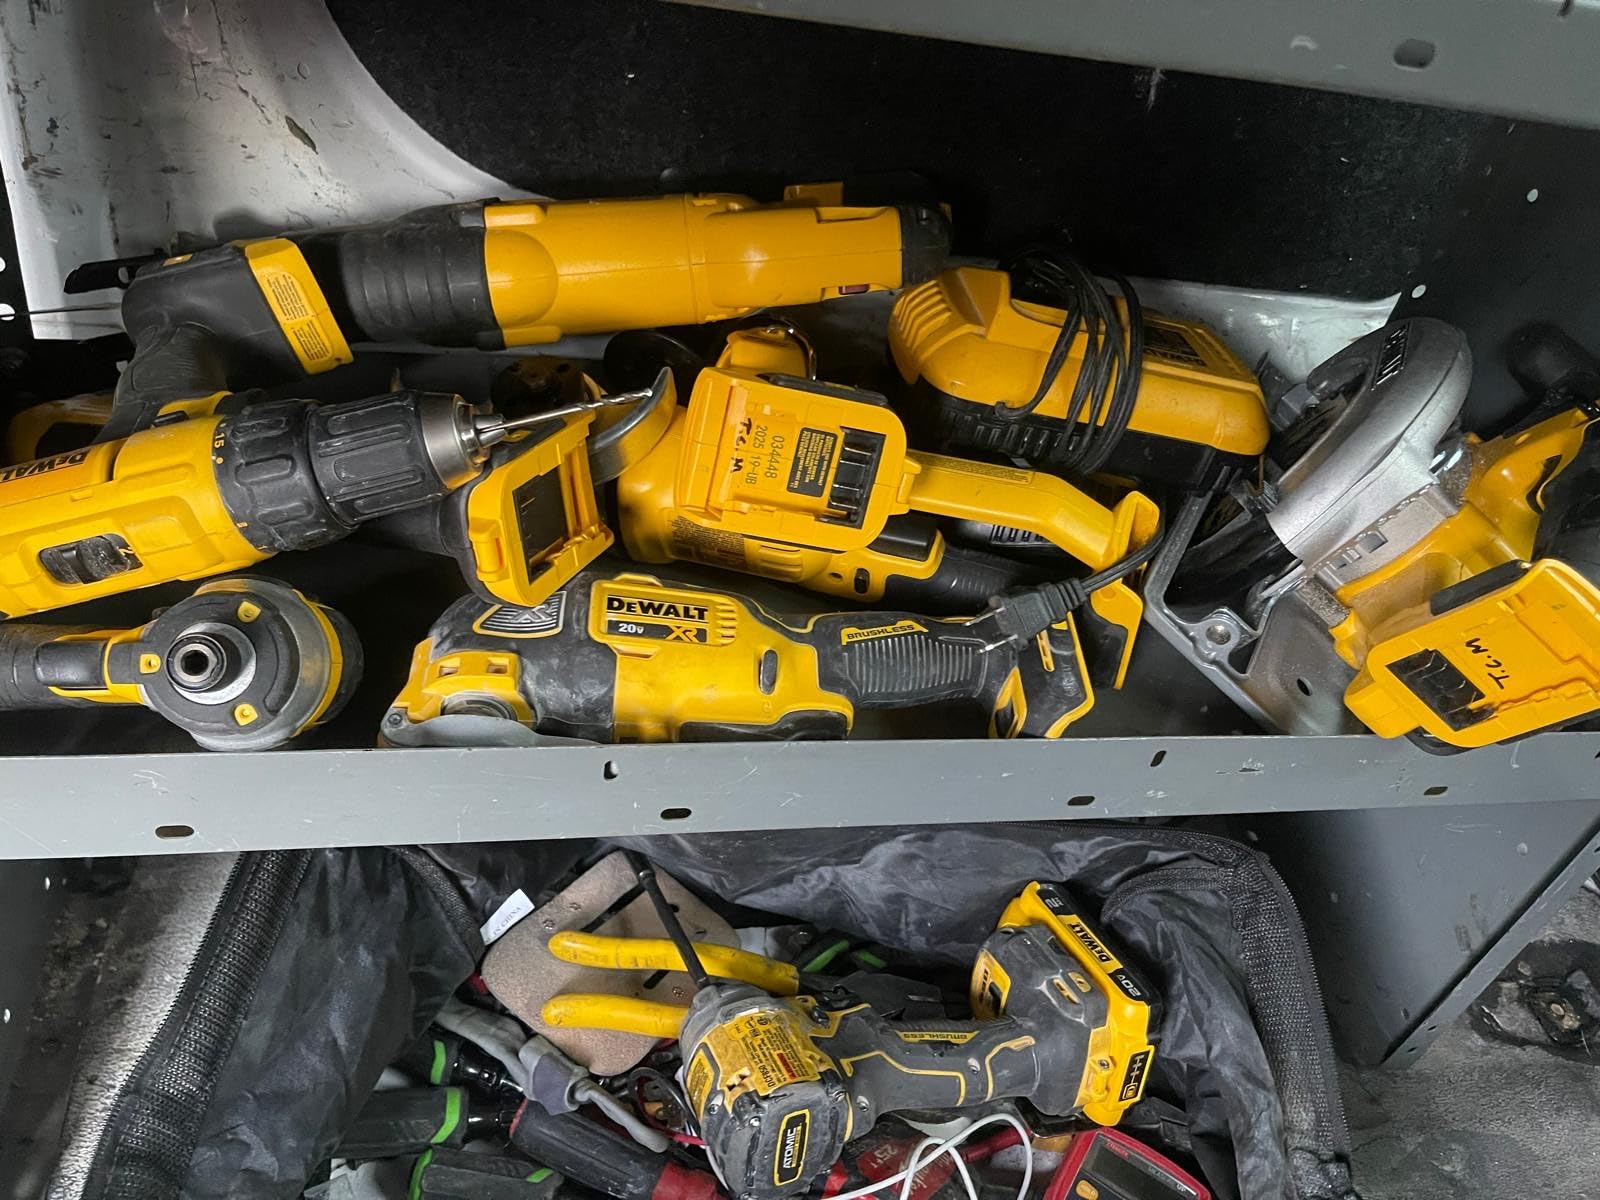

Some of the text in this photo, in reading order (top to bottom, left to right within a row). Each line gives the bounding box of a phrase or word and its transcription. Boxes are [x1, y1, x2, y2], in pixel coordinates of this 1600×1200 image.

[214, 433, 225, 449] 15
[753, 425, 768, 449] 2025
[0, 453, 87, 482] DEWAL
[764, 435, 785, 479] 034448
[606, 596, 709, 621] DEWALT
[665, 625, 700, 642] XR
[846, 624, 914, 640] BRUSHLESS
[1069, 922, 1113, 963] DEWALT
[758, 1064, 776, 1088] DCF850
[783, 1126, 798, 1169] ATOMIC
